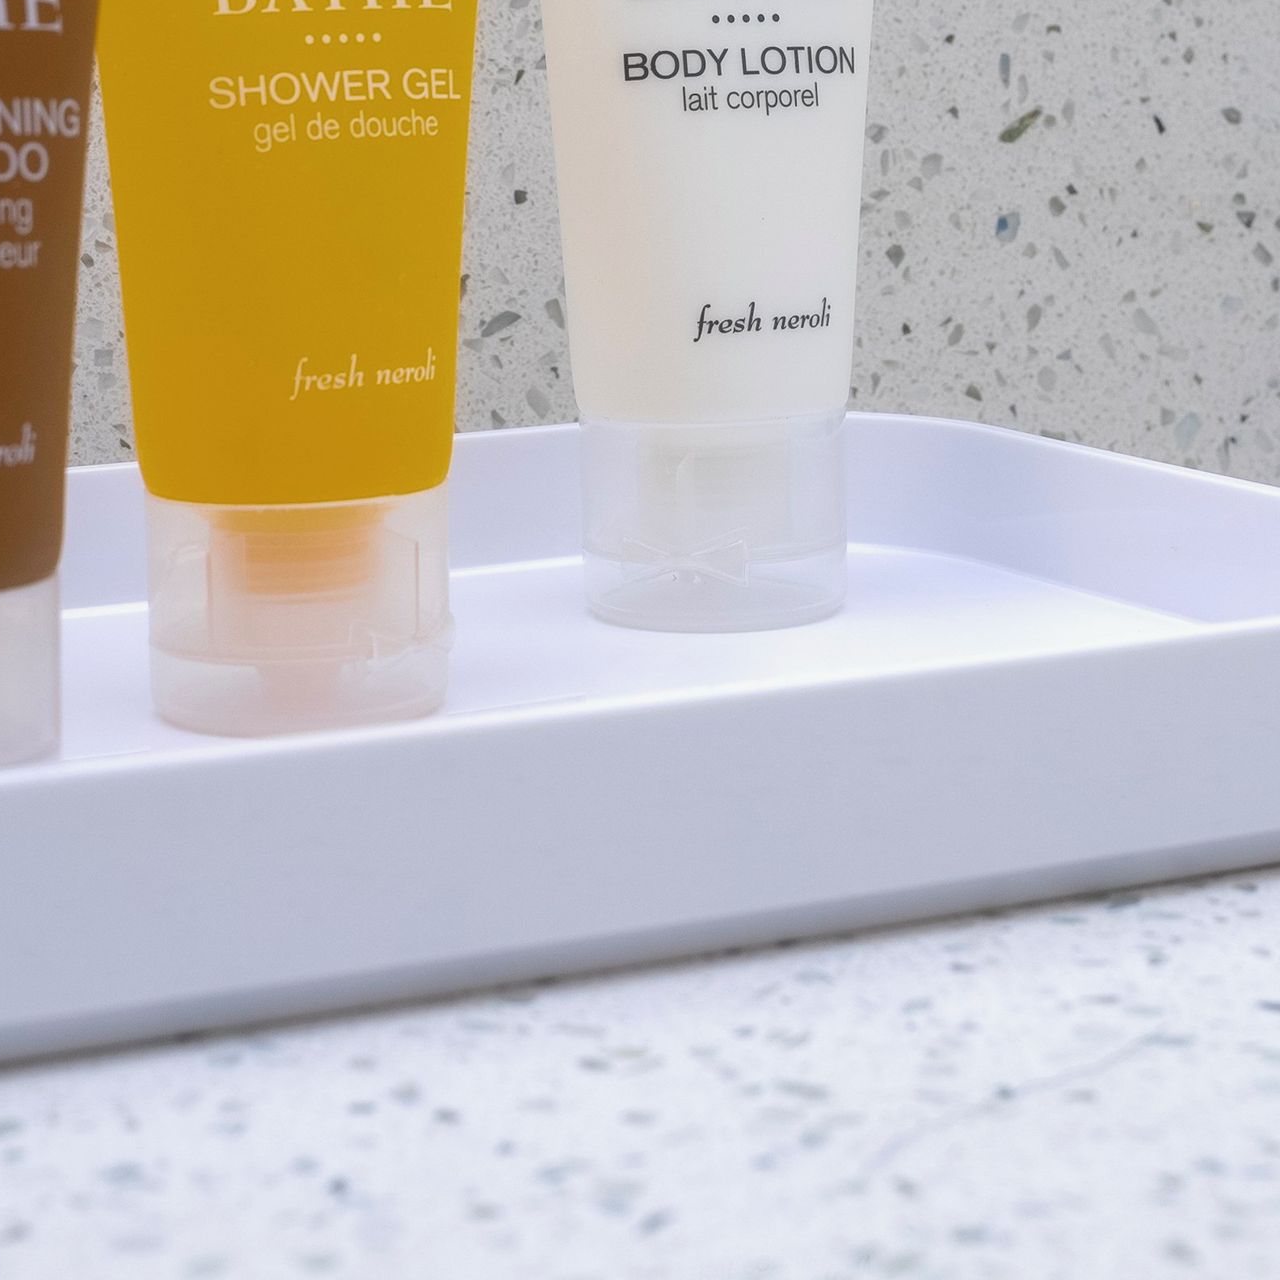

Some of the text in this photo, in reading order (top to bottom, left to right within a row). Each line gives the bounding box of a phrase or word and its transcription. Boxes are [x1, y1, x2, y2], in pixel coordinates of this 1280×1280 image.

[623, 45, 855, 81] BODY LOTION
[209, 68, 461, 109] SHOWER GEL
[682, 81, 820, 117] lait corporel
[254, 108, 439, 153] gel de douche
[693, 297, 831, 343] fresh neroli
[289, 346, 437, 401] fresh neroli
